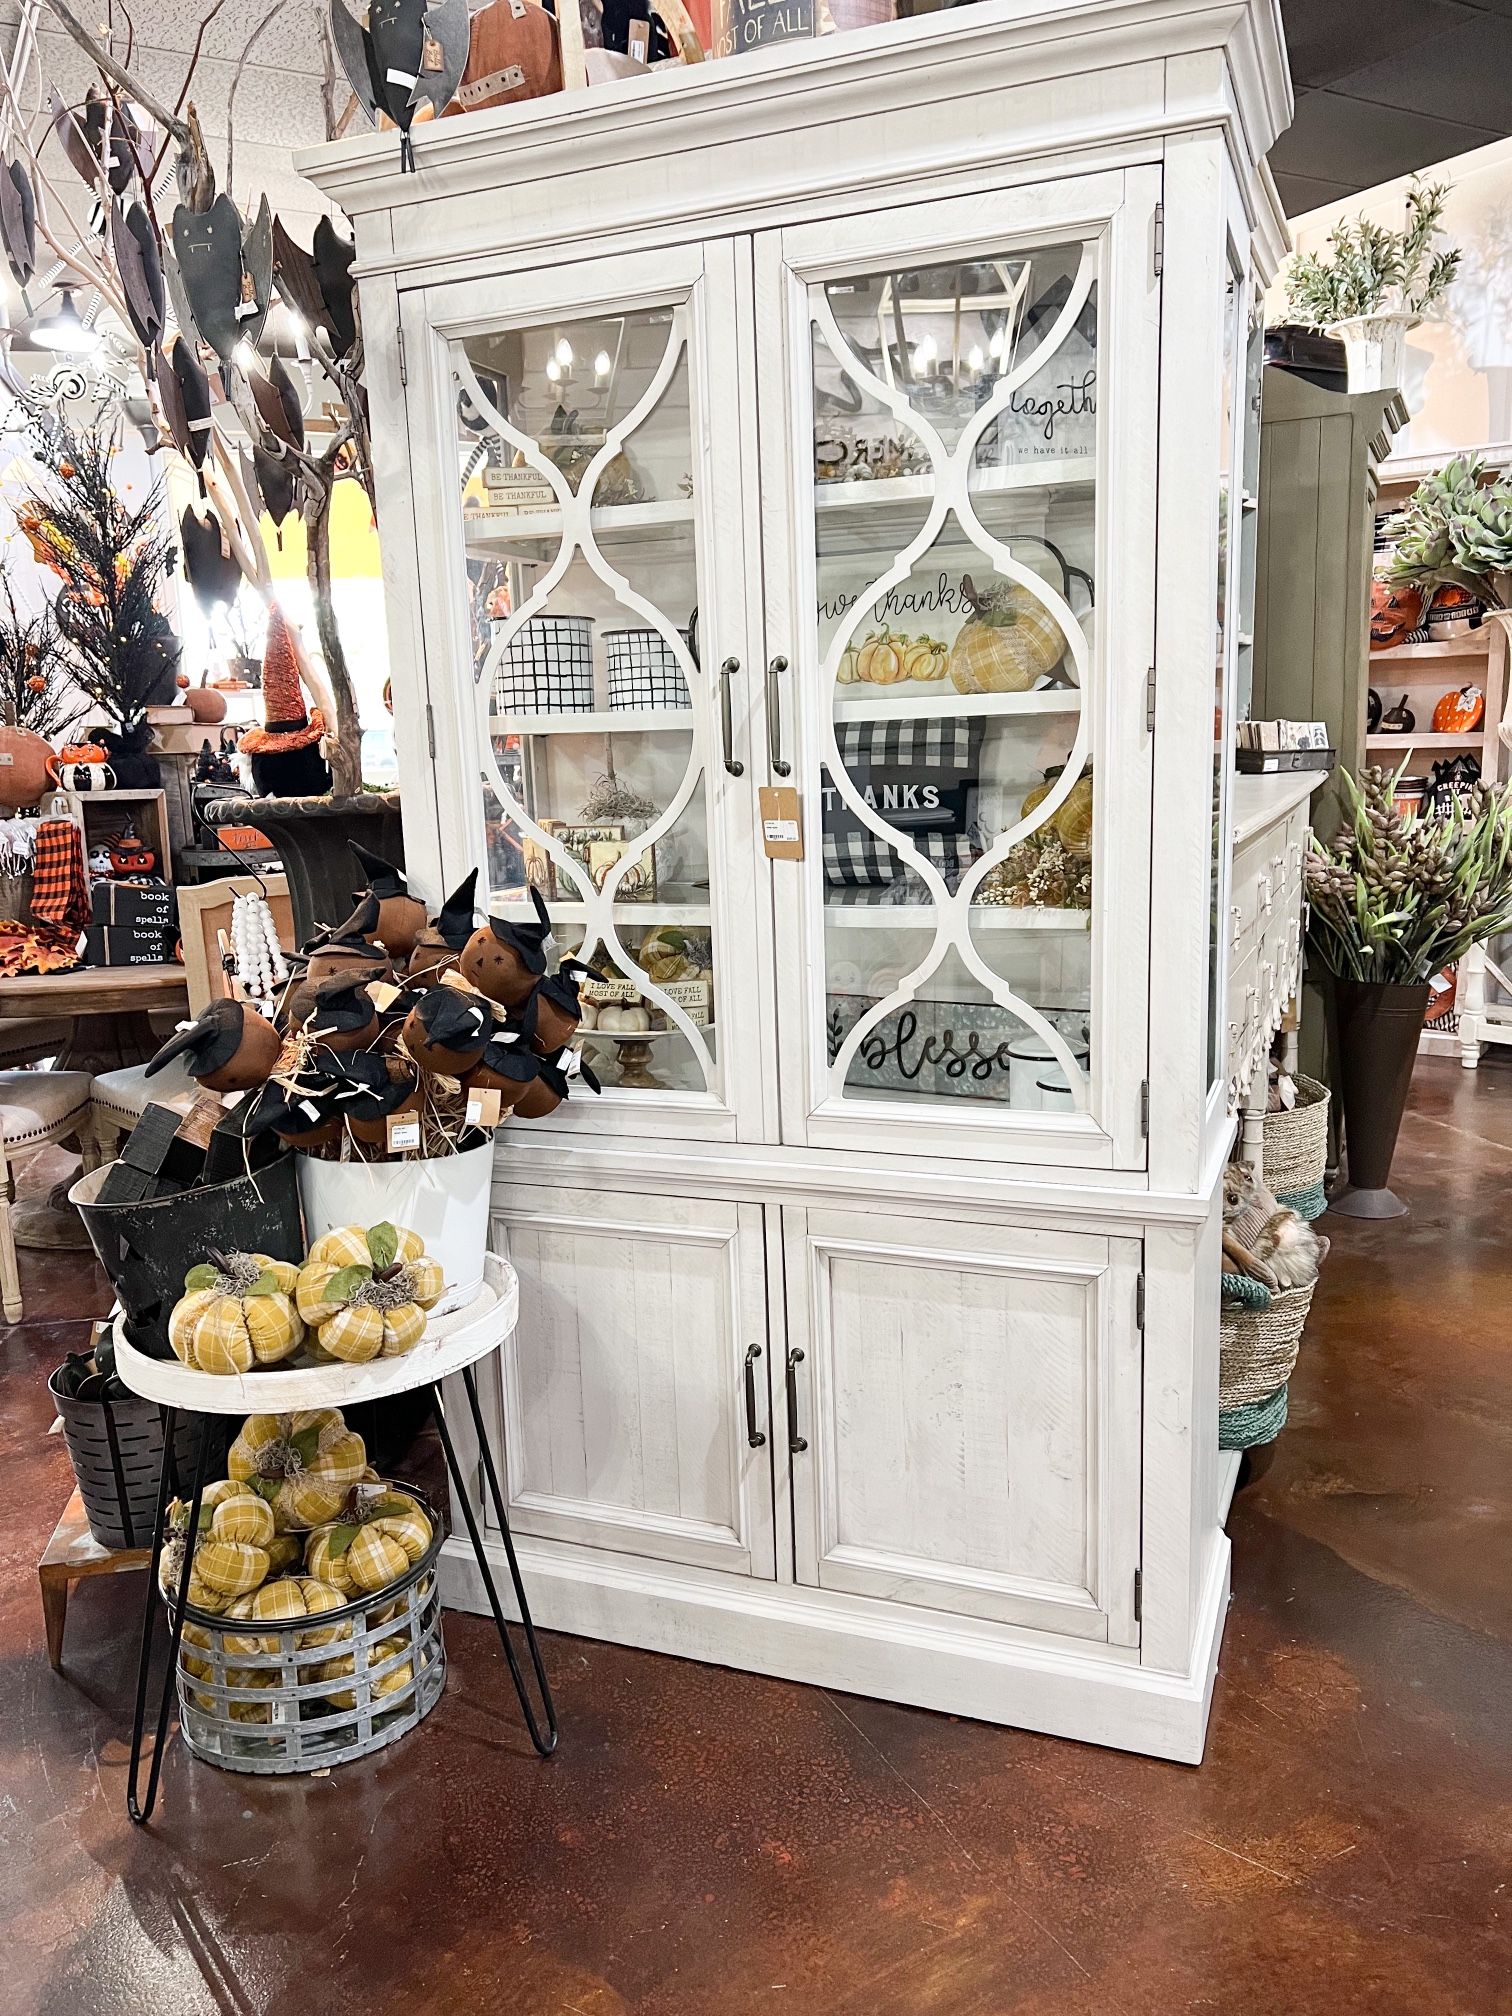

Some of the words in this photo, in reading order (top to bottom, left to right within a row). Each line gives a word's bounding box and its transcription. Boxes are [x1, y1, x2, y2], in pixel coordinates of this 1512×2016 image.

[744, 14, 765, 43] OF
[772, 7, 809, 35] ALL
[1011, 369, 1096, 440] togeth
[1033, 445, 1056, 454] have
[1060, 446, 1069, 454] it
[1073, 446, 1088, 454] all
[491, 473, 502, 481] BE
[503, 472, 543, 481] THANKFUL
[493, 492, 504, 501] BE
[506, 490, 547, 500] THANKFUL
[140, 891, 170, 902] book
[156, 905, 169, 914] of
[135, 915, 169, 925] spells
[133, 929, 163, 939] book
[149, 942, 163, 951] of
[129, 953, 164, 964] spells
[596, 982, 616, 990] LOVE
[617, 983, 636, 991] FALL
[684, 986, 702, 994] FALL
[588, 990, 609, 998] MOST
[609, 990, 620, 998] OF
[620, 990, 635, 998] ALL
[677, 995, 688, 1003] OF
[689, 994, 703, 1002] ALL
[860, 1009, 1010, 1080] blesse
